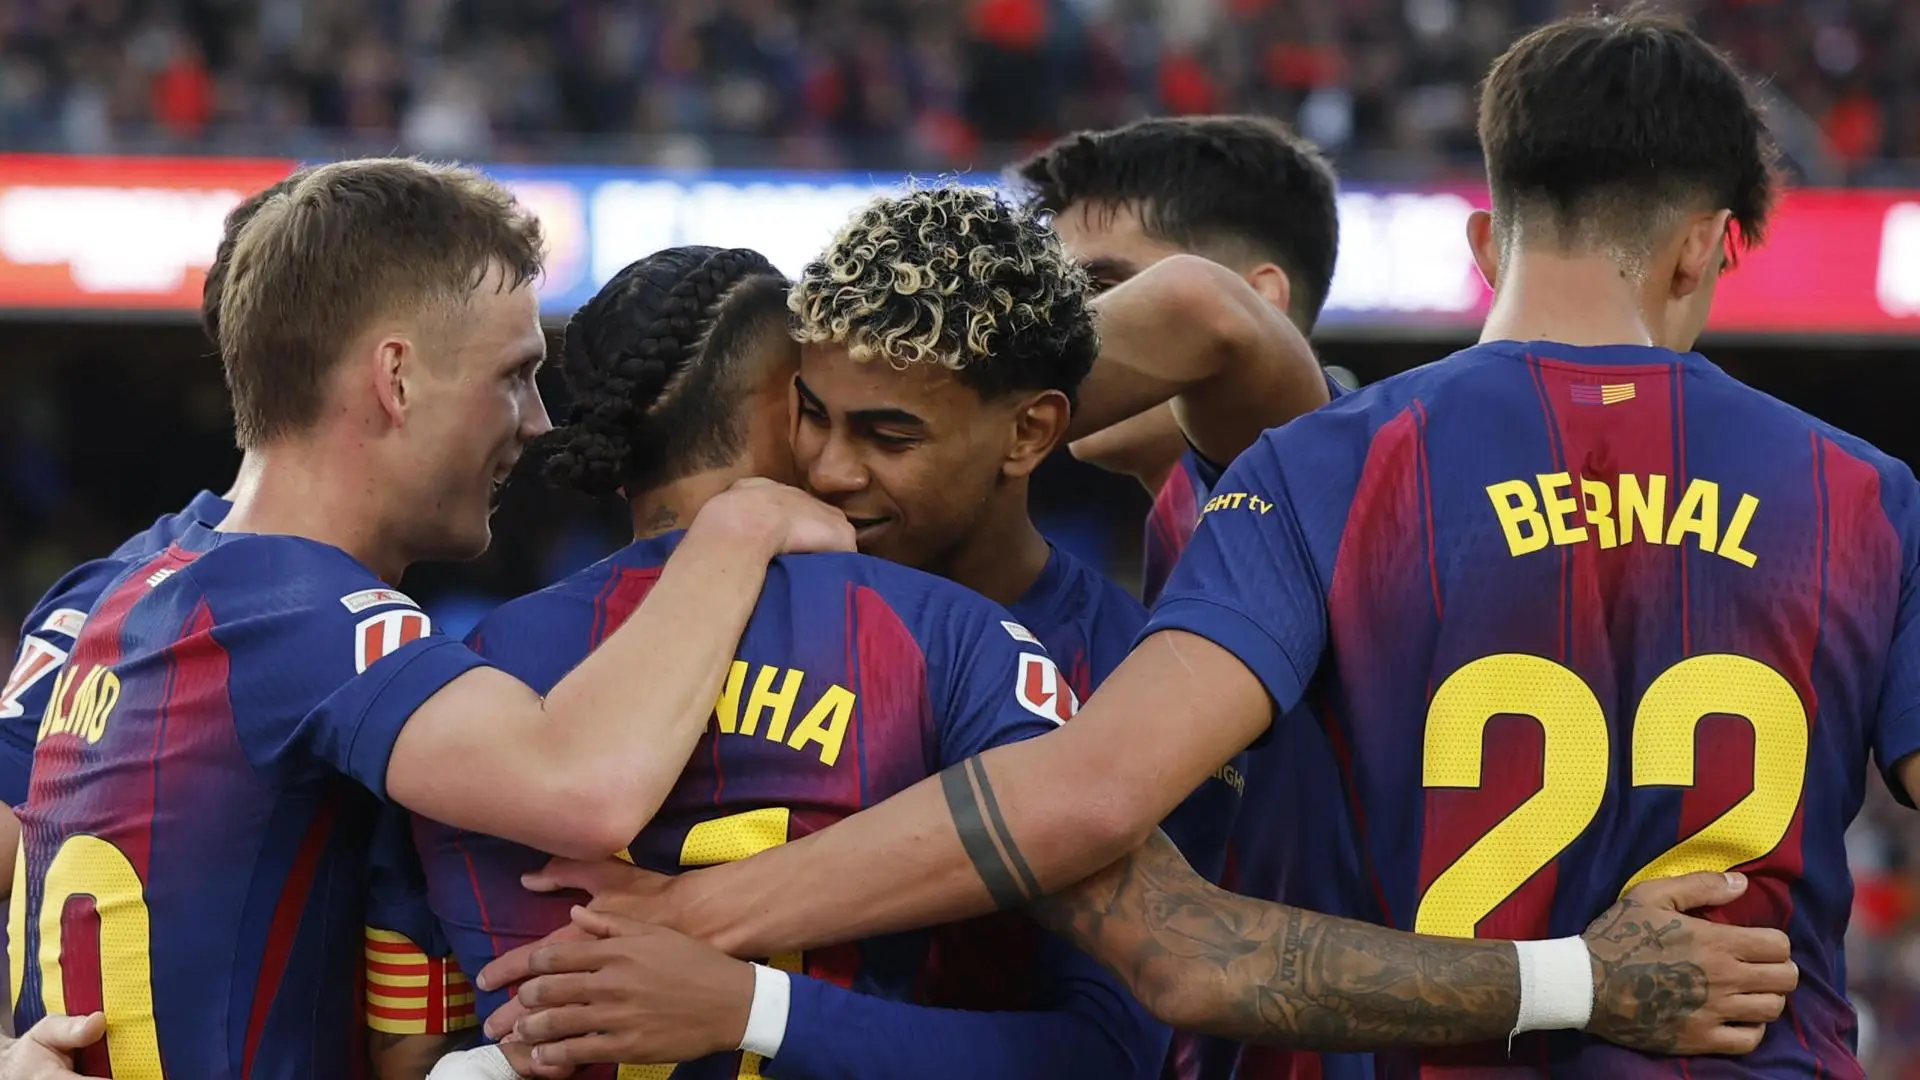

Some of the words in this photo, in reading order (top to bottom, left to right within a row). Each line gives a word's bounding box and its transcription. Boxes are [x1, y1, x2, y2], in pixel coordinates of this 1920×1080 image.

[1248, 494, 1274, 514] tv
[1485, 471, 1760, 569] BERNAL
[1414, 652, 1809, 939] 22
